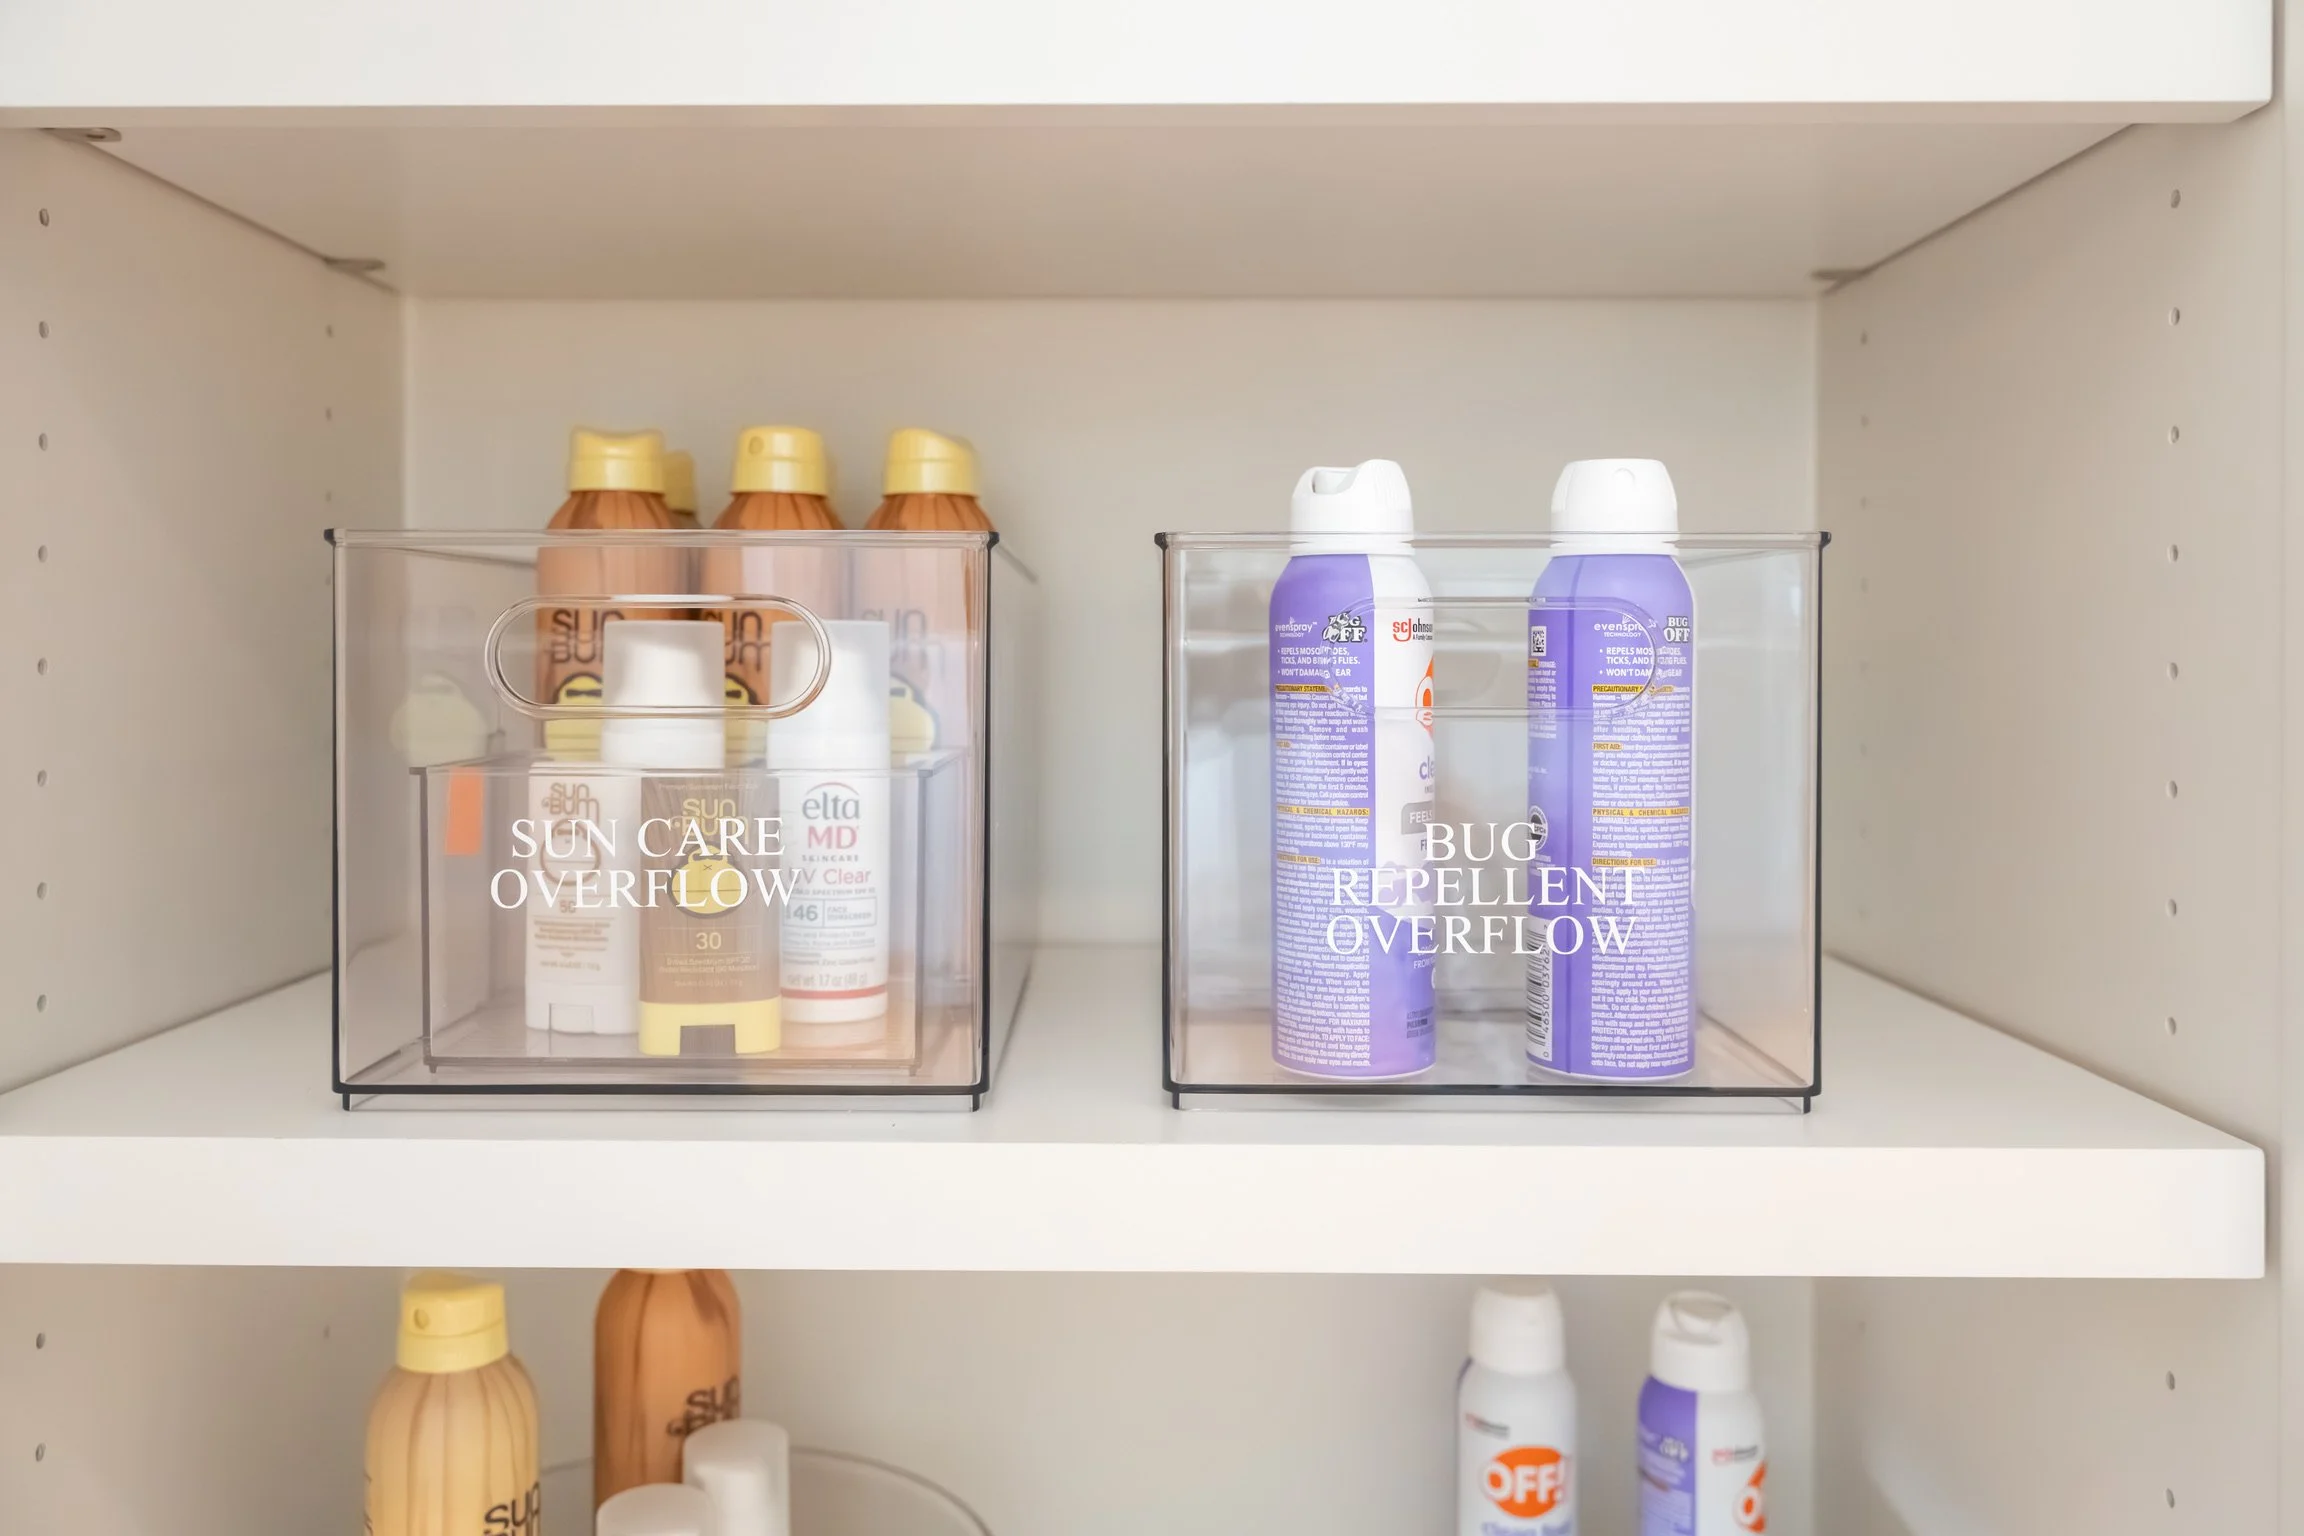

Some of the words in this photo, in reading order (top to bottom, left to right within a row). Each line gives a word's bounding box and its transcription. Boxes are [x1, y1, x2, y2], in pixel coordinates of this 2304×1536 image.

[1667, 616, 1689, 627] BUG
[1663, 627, 1691, 642] OFF
[1606, 647, 1635, 655] REPELS
[1297, 656, 1312, 665] AND
[1338, 656, 1361, 665] FLIES.
[1606, 656, 1632, 666] TICKS,
[1632, 656, 1650, 665] AND
[1606, 668, 1634, 677] WON'T
[802, 790, 861, 821] elta
[512, 818, 619, 858] SUN
[637, 817, 786, 858] CARE
[807, 825, 858, 849] MD
[1424, 822, 1540, 862] BUG
[823, 867, 871, 885] Clear
[490, 868, 802, 909] OVERFLOW
[1329, 866, 1647, 907] REPELLENT
[793, 904, 819, 921] 46
[696, 931, 722, 950] 30
[1326, 914, 1640, 955] OVERFLOW
